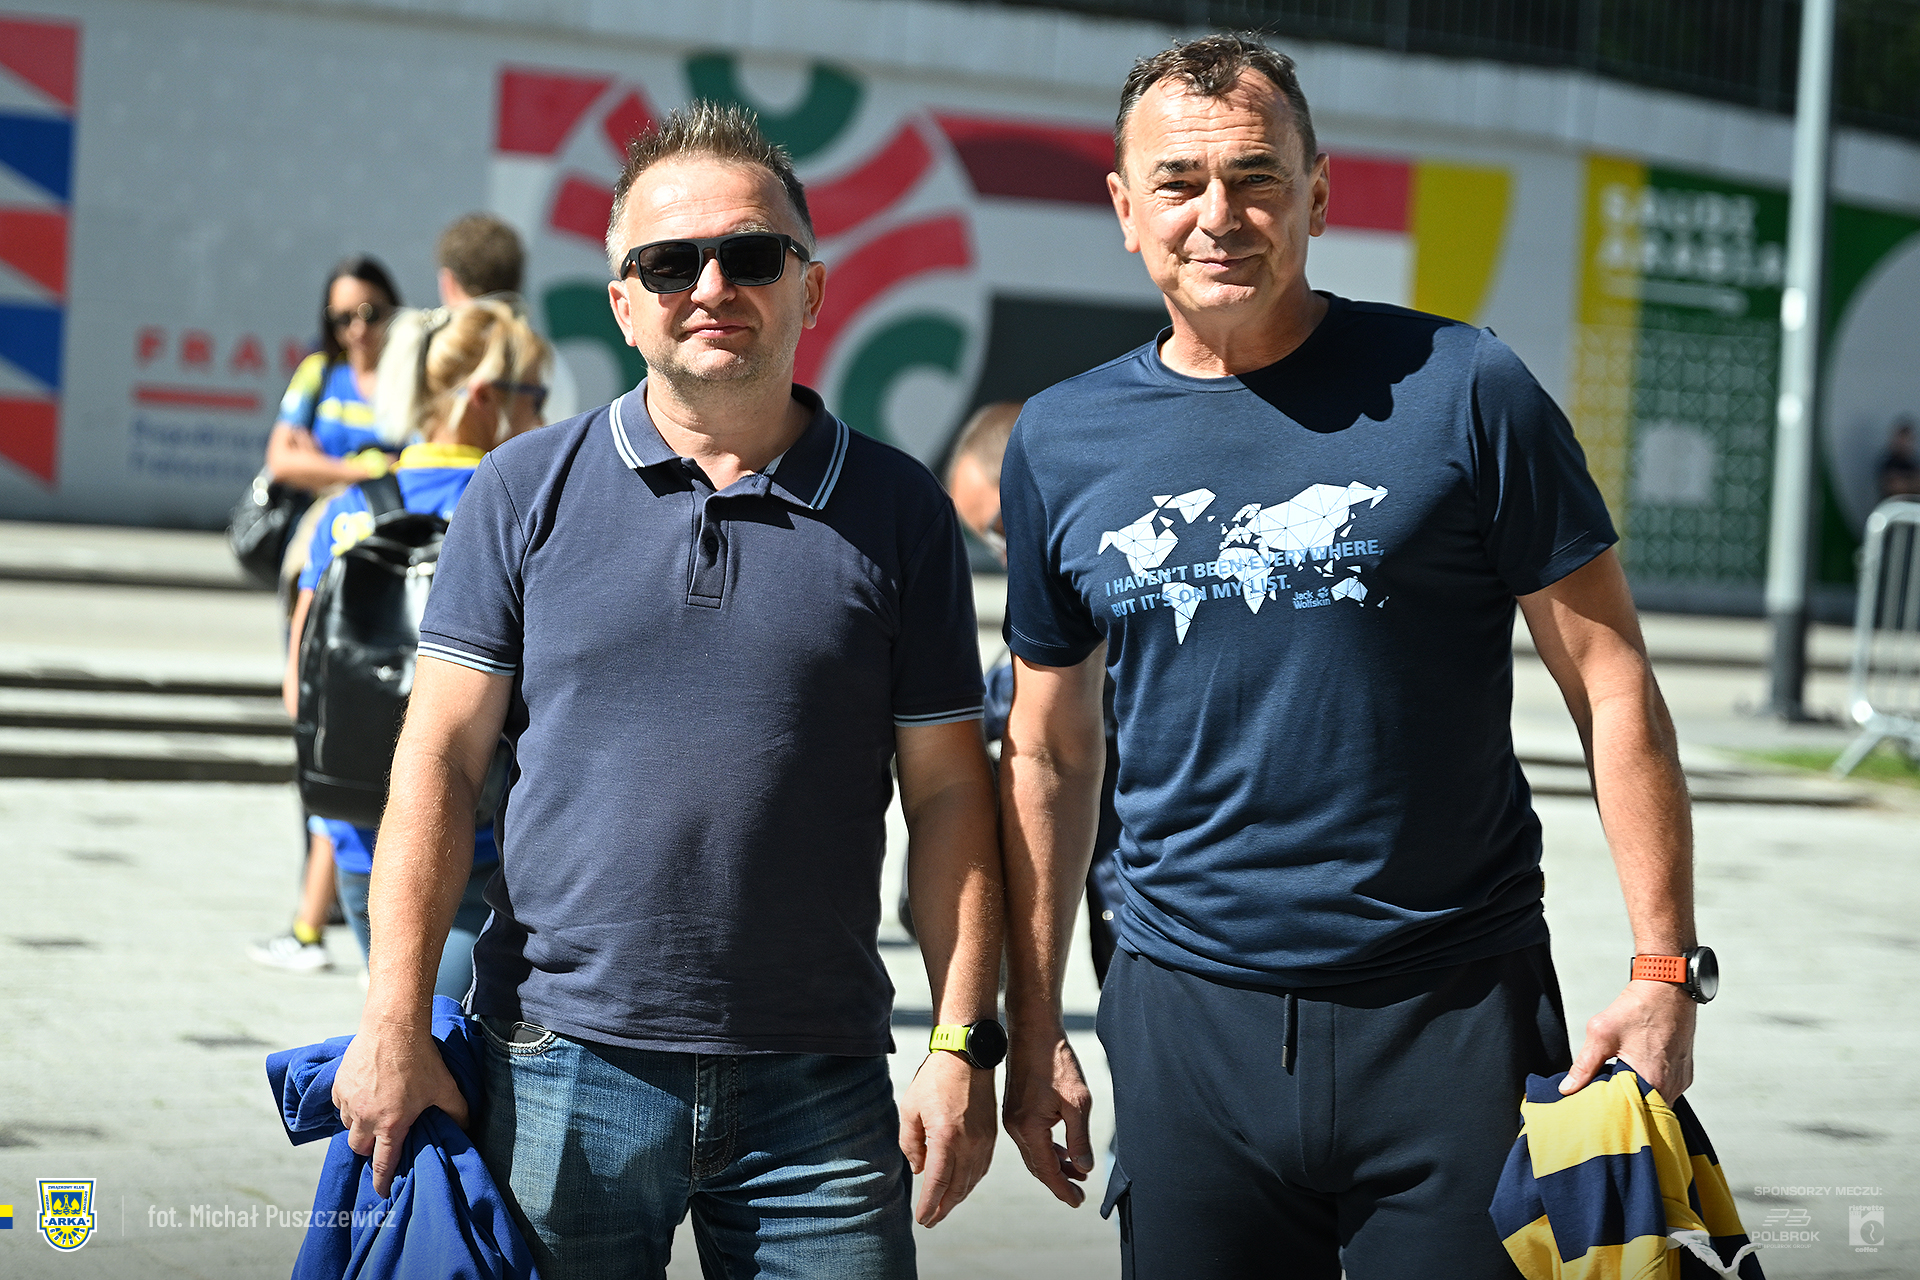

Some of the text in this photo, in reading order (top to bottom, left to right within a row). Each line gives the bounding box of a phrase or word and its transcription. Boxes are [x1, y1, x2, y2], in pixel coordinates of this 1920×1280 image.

[1105, 539, 1385, 597] I HAVEN'T BEEN EVERYWHERE,
[1110, 574, 1292, 617] BUT IT'S ON MY LIST.
[1292, 590, 1314, 600] Jack
[1292, 598, 1332, 610] Wolfskin
